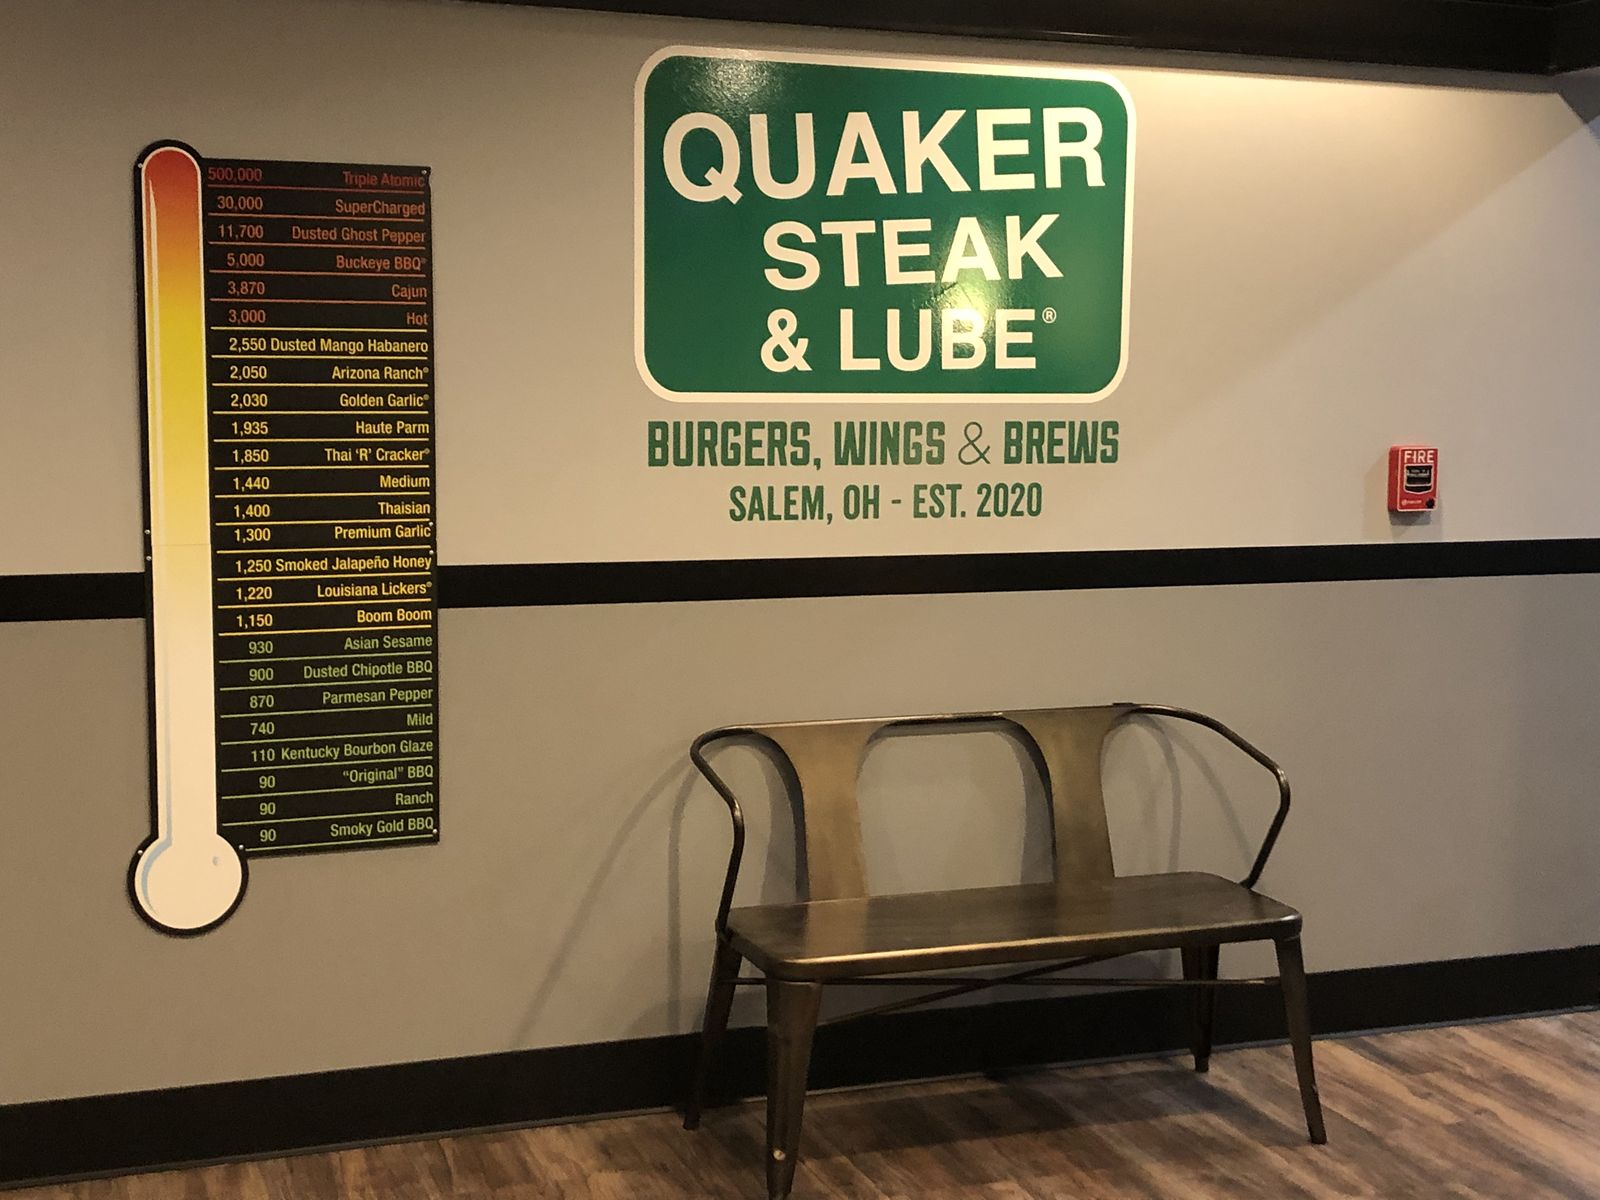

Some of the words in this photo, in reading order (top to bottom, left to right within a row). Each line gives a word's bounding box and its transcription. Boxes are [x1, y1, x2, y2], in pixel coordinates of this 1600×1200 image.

[662, 107, 1106, 205] QUAKER
[208, 167, 262, 182] 500,000
[343, 171, 377, 188] Triple
[217, 196, 263, 211] 30,000
[335, 199, 426, 217] SuperCharged
[218, 224, 264, 239] 11,700
[292, 226, 337, 241] Dusted
[342, 228, 378, 241] Ghost
[382, 229, 426, 245] Pepper
[227, 253, 264, 268] 5,000
[336, 255, 390, 270] Buckeye
[762, 214, 1064, 290] STEAK
[228, 281, 265, 296] 3,870
[392, 284, 427, 299] Cajun
[229, 310, 266, 324] 3,000
[407, 313, 428, 326] Hot
[229, 338, 266, 352] 2,550
[271, 338, 316, 352] Dusted
[320, 339, 364, 354] Mango
[368, 339, 428, 353] Habanero
[761, 308, 812, 372] &
[230, 366, 267, 381] 2,050
[332, 367, 380, 380] Arizona
[231, 394, 268, 409] 2,030
[340, 394, 383, 407] Golden
[231, 422, 268, 436] 1,935
[356, 421, 392, 434] Haute
[396, 421, 429, 434] Parm
[647, 421, 822, 470] BURGERS,
[833, 421, 946, 465] WINGS
[957, 422, 991, 465] &
[1003, 420, 1119, 465] BREWS
[232, 449, 269, 464] 1,850
[325, 449, 352, 462] Thai
[1404, 450, 1434, 463] FIRE
[233, 477, 270, 492] 1,440
[380, 475, 430, 488] Medium
[233, 504, 270, 519] 1,400
[378, 501, 431, 515] Thaisian
[729, 484, 832, 524] SALEM,
[843, 484, 880, 520] OH
[913, 483, 967, 518] EST.
[976, 481, 1043, 517] 2020
[234, 529, 271, 543] 1,300
[335, 527, 391, 539] Premium
[236, 560, 272, 574] 1,250
[276, 558, 328, 572] Smoked
[332, 556, 389, 571] Jalapeño
[394, 556, 432, 570] Honey
[236, 587, 272, 601] 1,220
[317, 583, 378, 598] Louisiana
[237, 614, 273, 629] 1,150
[357, 610, 393, 623] Boom
[397, 609, 432, 622] Boom
[249, 641, 273, 654] 930
[344, 637, 379, 650] Asian
[383, 635, 433, 648] Sesame
[249, 668, 274, 681] 900
[304, 664, 348, 679] Dusted
[352, 662, 403, 679] Chipotle
[407, 660, 433, 674] BBQ
[250, 696, 274, 708] 870
[322, 690, 386, 704] Parmesan
[390, 688, 433, 704] Pepper
[251, 722, 275, 735] 740
[407, 713, 433, 726] Mild
[251, 749, 275, 762] 110
[281, 745, 340, 760] Kentucky
[344, 742, 396, 756] Bourbon
[400, 740, 433, 753] Glaze
[259, 776, 275, 788] 90
[408, 765, 433, 779] BBQ
[259, 803, 276, 815] 90
[396, 792, 433, 805] Ranch
[260, 829, 276, 842] 90
[331, 823, 373, 837] Smoky
[376, 820, 404, 833] Gold
[408, 817, 433, 831] BBQ
